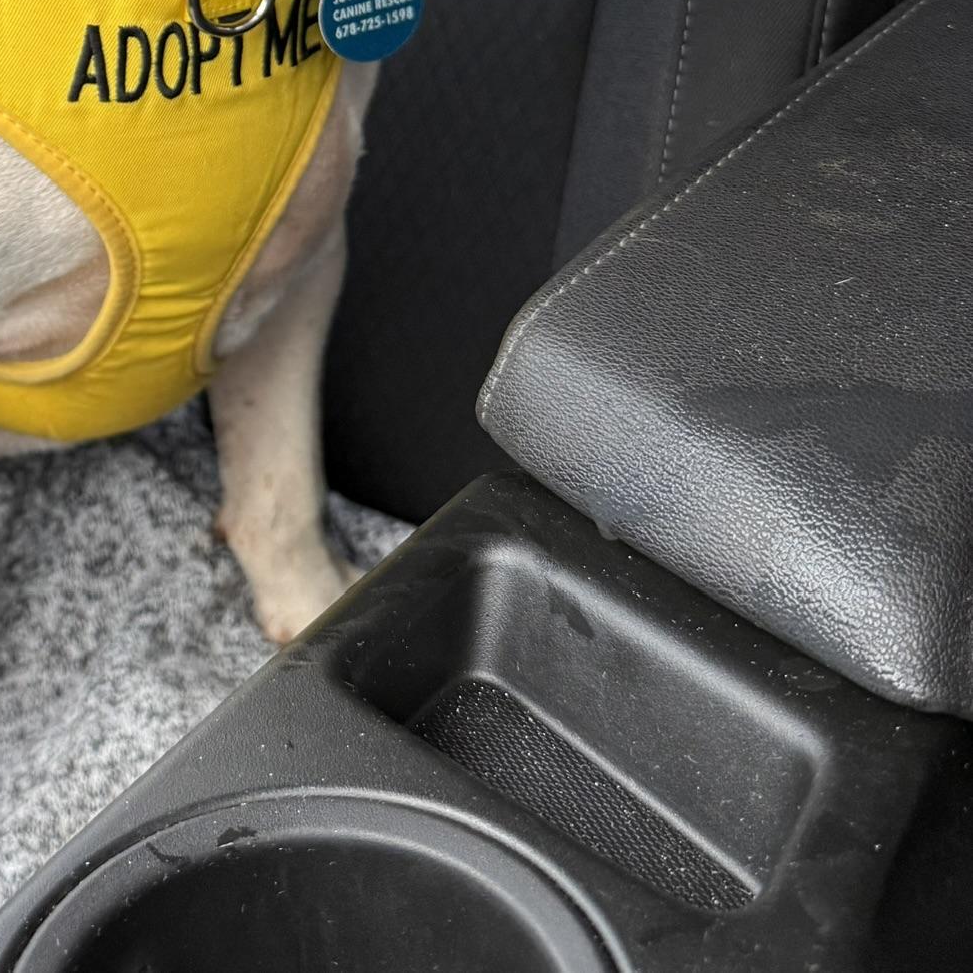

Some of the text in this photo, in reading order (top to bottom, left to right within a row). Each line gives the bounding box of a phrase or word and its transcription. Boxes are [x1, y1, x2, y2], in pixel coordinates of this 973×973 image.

[332, 0, 372, 22] CANINE
[335, 6, 414, 40] 678-725-1598
[67, 7, 252, 103] ADOPT
